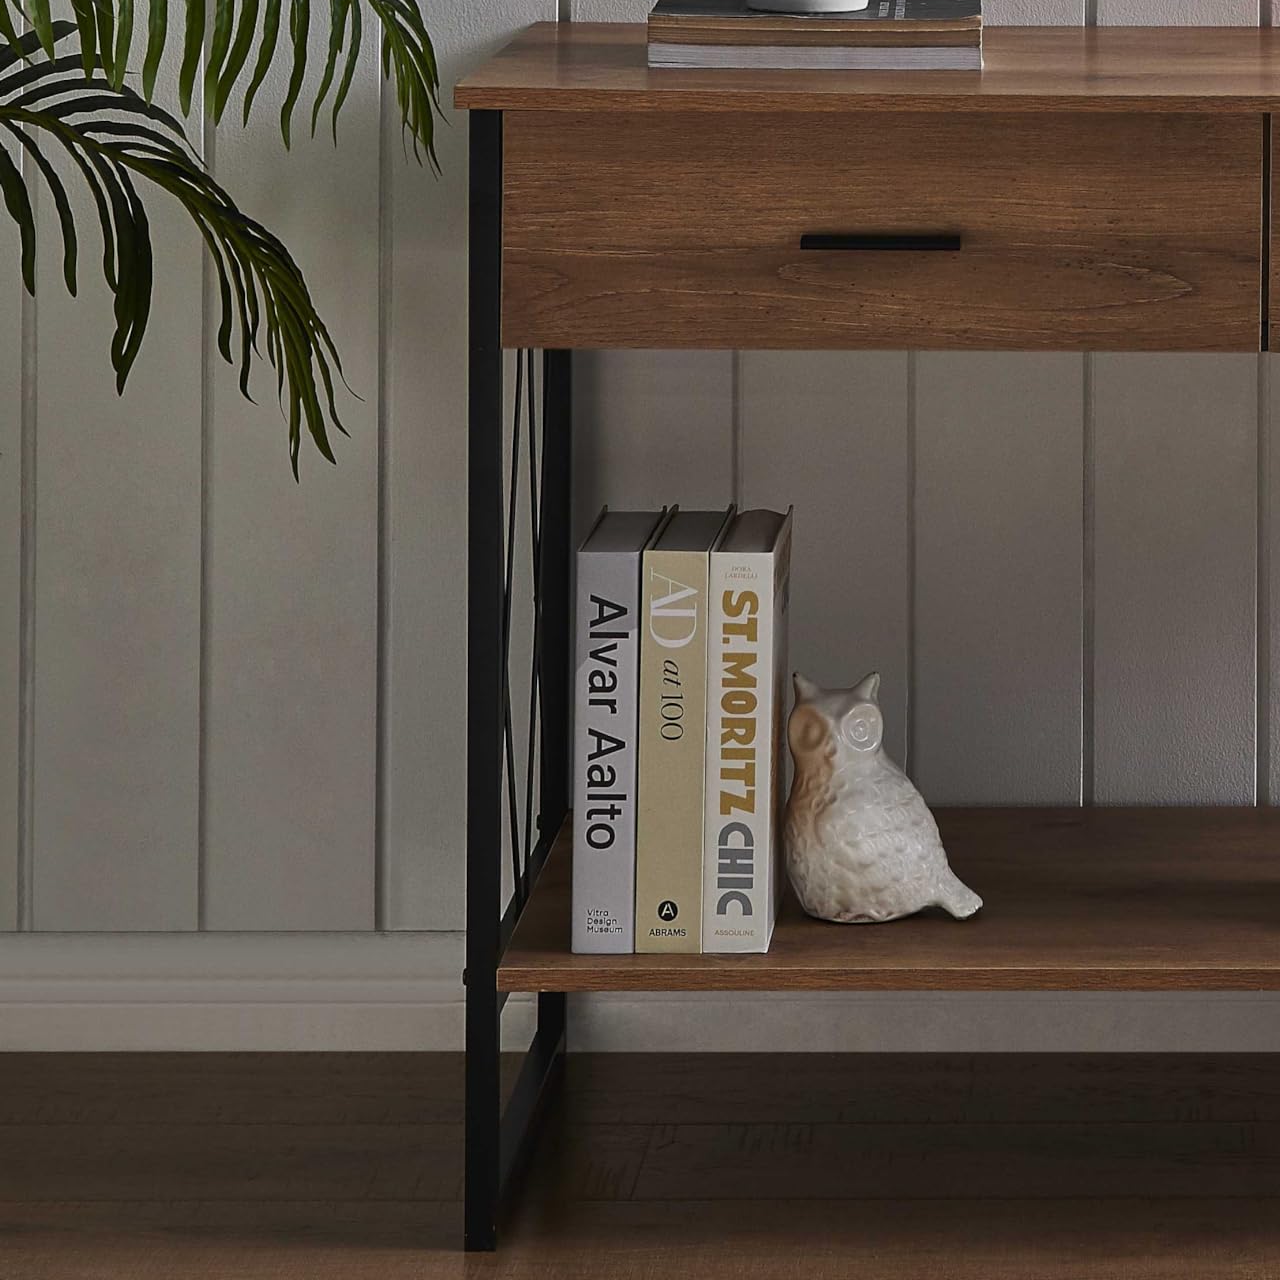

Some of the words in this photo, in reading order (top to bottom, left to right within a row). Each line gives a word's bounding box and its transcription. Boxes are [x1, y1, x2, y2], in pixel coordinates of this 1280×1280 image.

[649, 567, 699, 649] AD
[721, 589, 760, 645] ST.
[588, 593, 630, 714] Alvar
[662, 658, 681, 688] at
[659, 692, 684, 740] 100
[719, 652, 759, 816] MORITZ
[585, 727, 627, 850] Aalto
[716, 821, 755, 917] CHIC
[586, 908, 609, 917] Vitra
[586, 917, 618, 926] Design
[586, 925, 624, 934] Museum
[648, 927, 687, 938] ABRAMS
